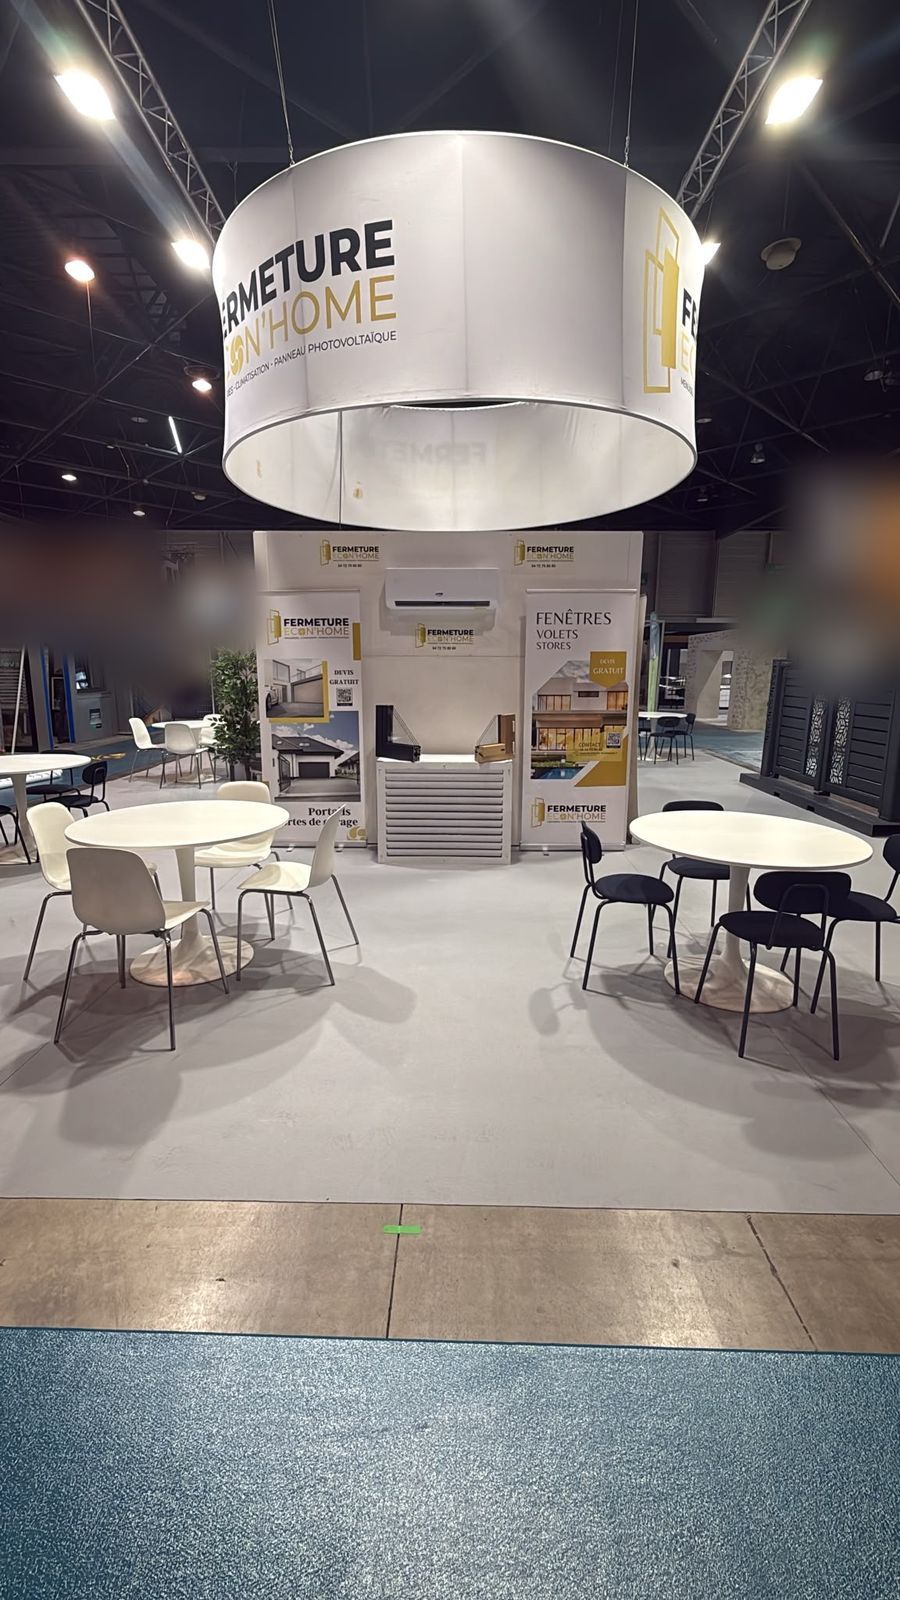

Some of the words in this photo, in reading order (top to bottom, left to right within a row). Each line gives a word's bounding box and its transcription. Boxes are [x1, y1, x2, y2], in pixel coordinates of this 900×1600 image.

[222, 219, 395, 340] ERMETURE
[226, 274, 397, 380] ON'HOME
[235, 362, 270, 391] CLIMATISATION
[274, 345, 306, 368] PANNEAU
[308, 331, 397, 354] PHOTOVOLTAÏQUE
[536, 608, 612, 625] FENÊTRES
[283, 618, 350, 627] FERMETURE
[284, 627, 350, 636] ECON'HOME
[536, 629, 579, 640] VOLETS
[536, 641, 572, 650] STORES
[592, 667, 624, 675] GRATUIT
[308, 806, 351, 816] Portals
[547, 804, 607, 812] FERMETURE
[547, 812, 606, 820] ECON'HOME
[285, 818, 307, 826] rtes
[309, 817, 321, 826] de
